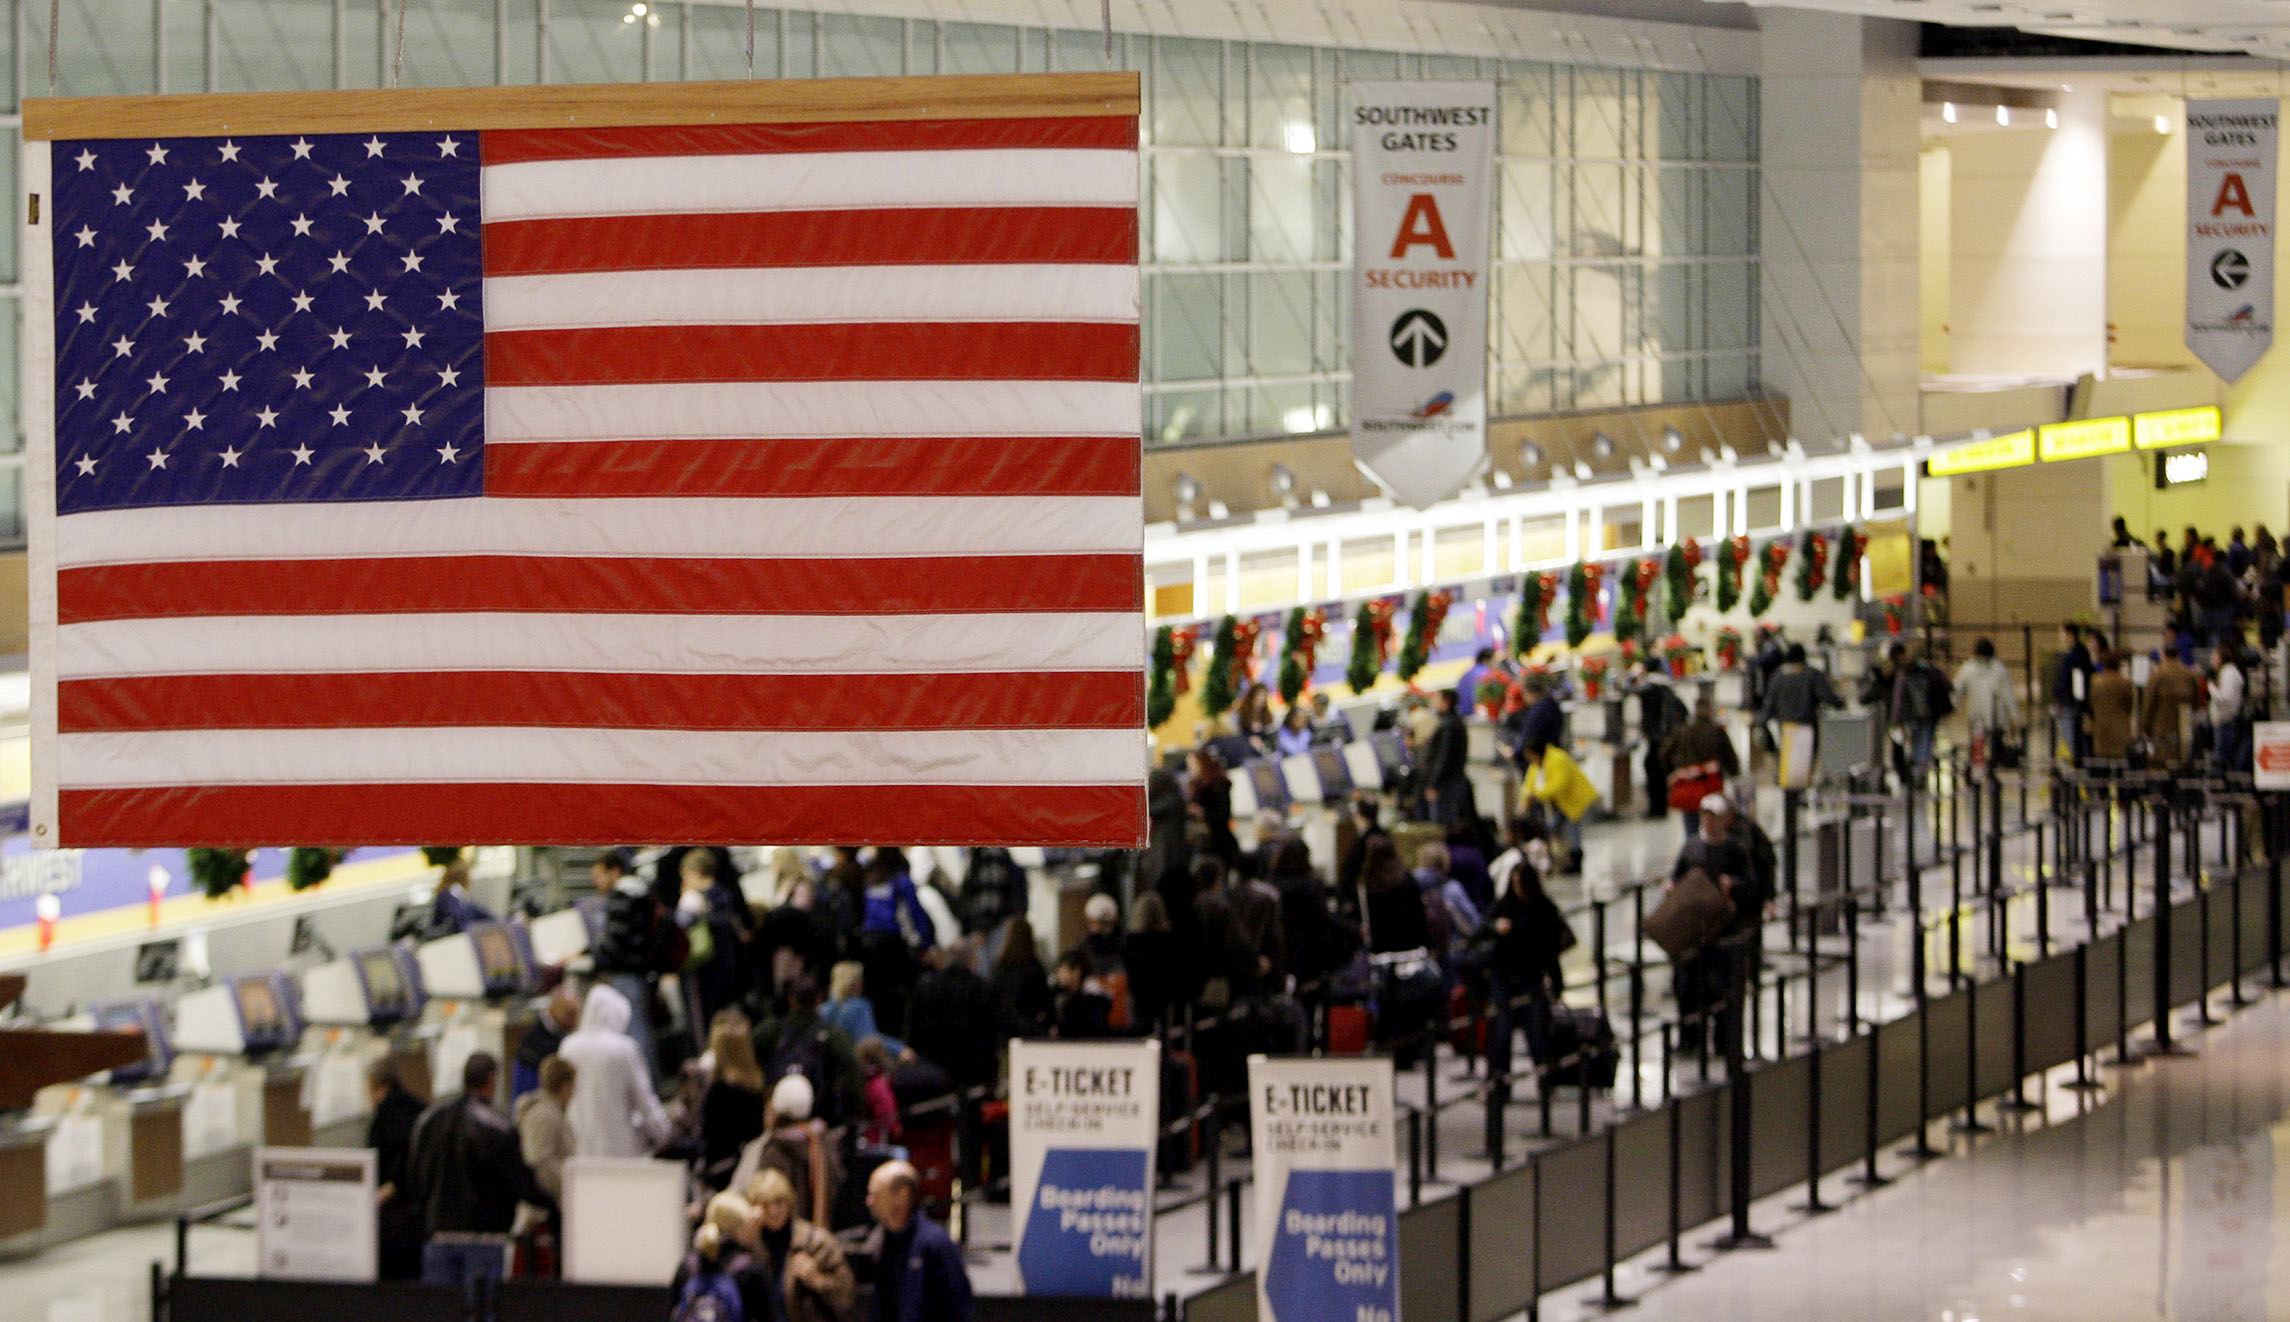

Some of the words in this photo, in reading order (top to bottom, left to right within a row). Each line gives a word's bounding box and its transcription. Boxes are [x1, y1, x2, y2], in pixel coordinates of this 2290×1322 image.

[1355, 106, 1490, 126] SOUTHWEST
[1381, 132, 1459, 152] GATES
[2210, 172, 2256, 217] A
[1389, 193, 1457, 260] A
[1365, 269, 1477, 290] SECURITY
[1024, 1066, 1134, 1096] E-TICKET
[1265, 1084, 1370, 1115] E-TICKET
[1040, 1184, 1144, 1213] Boarding
[1061, 1208, 1142, 1234] Passes
[1286, 1208, 1387, 1238] Boarding
[1090, 1231, 1144, 1260] Only
[1306, 1235, 1386, 1260] Passes
[1334, 1259, 1390, 1288] Only
